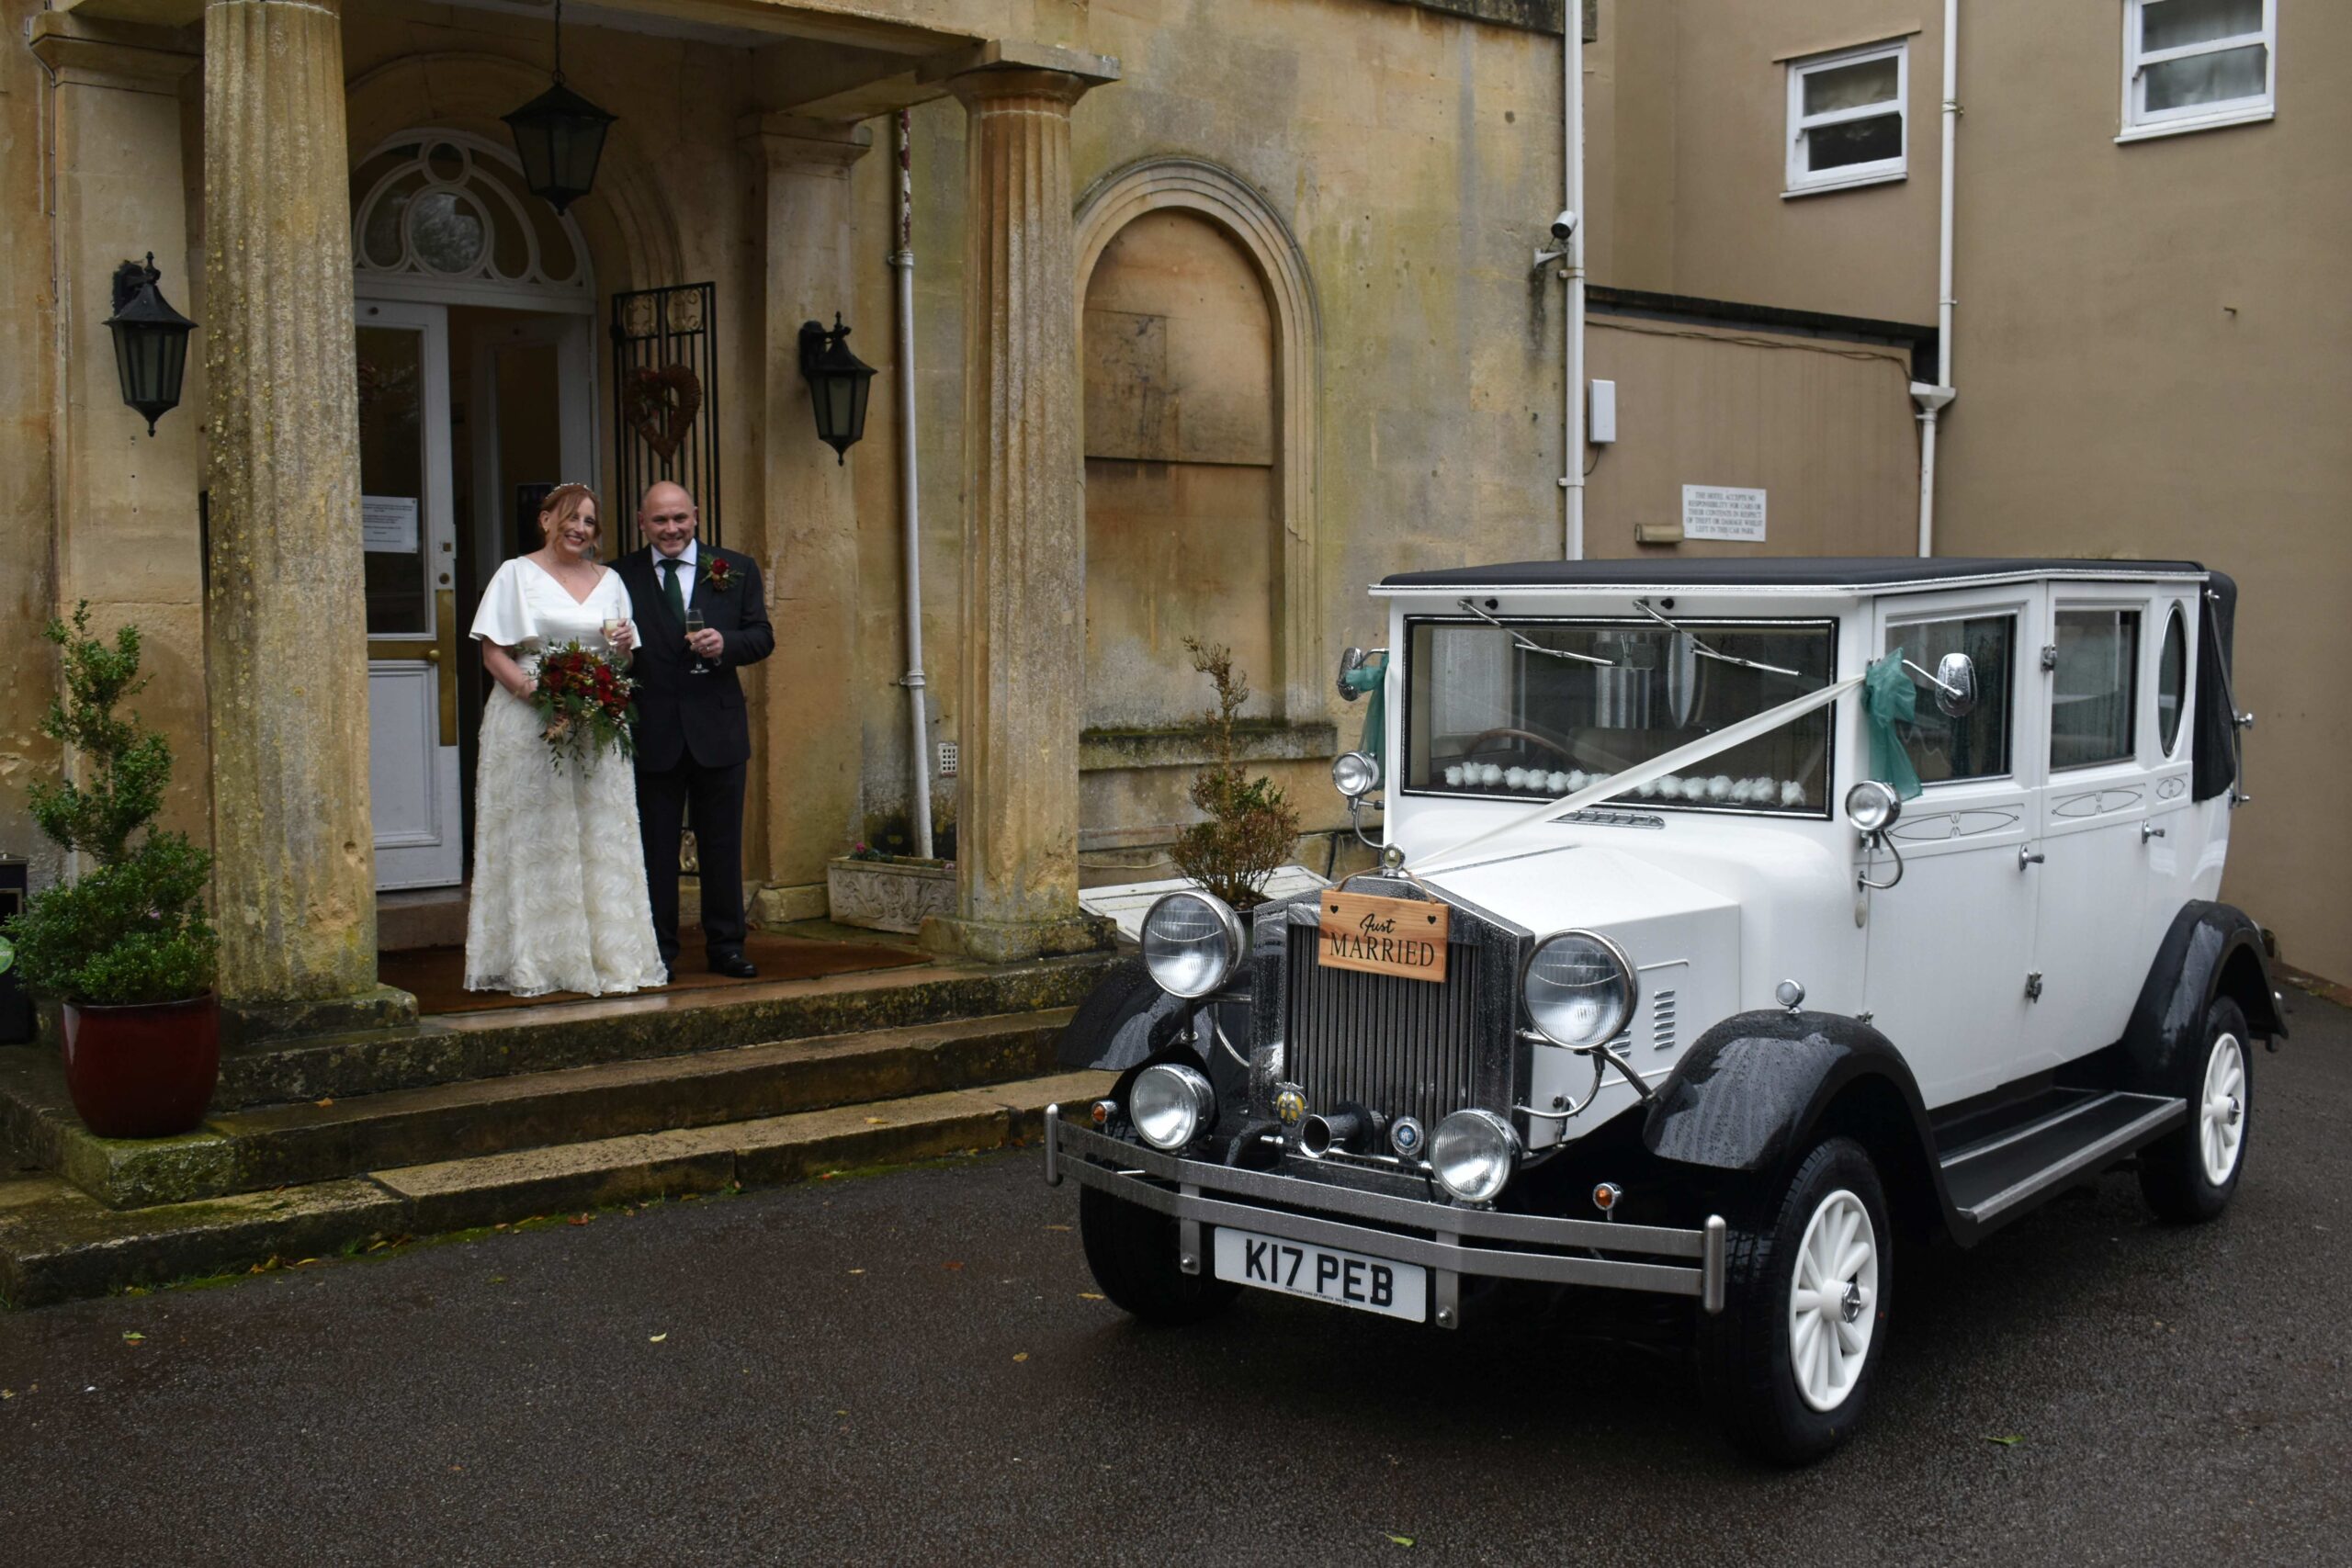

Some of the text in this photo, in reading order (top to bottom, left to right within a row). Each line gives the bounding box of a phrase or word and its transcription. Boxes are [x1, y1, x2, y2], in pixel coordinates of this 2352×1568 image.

[1688, 500, 1727, 508] RESPONSIBILITY
[1721, 518, 1743, 526] DAMAGE
[1360, 913, 1396, 936] Just
[1330, 932, 1435, 967] MARRIED
[1246, 1238, 1393, 1307] K17 PEB
